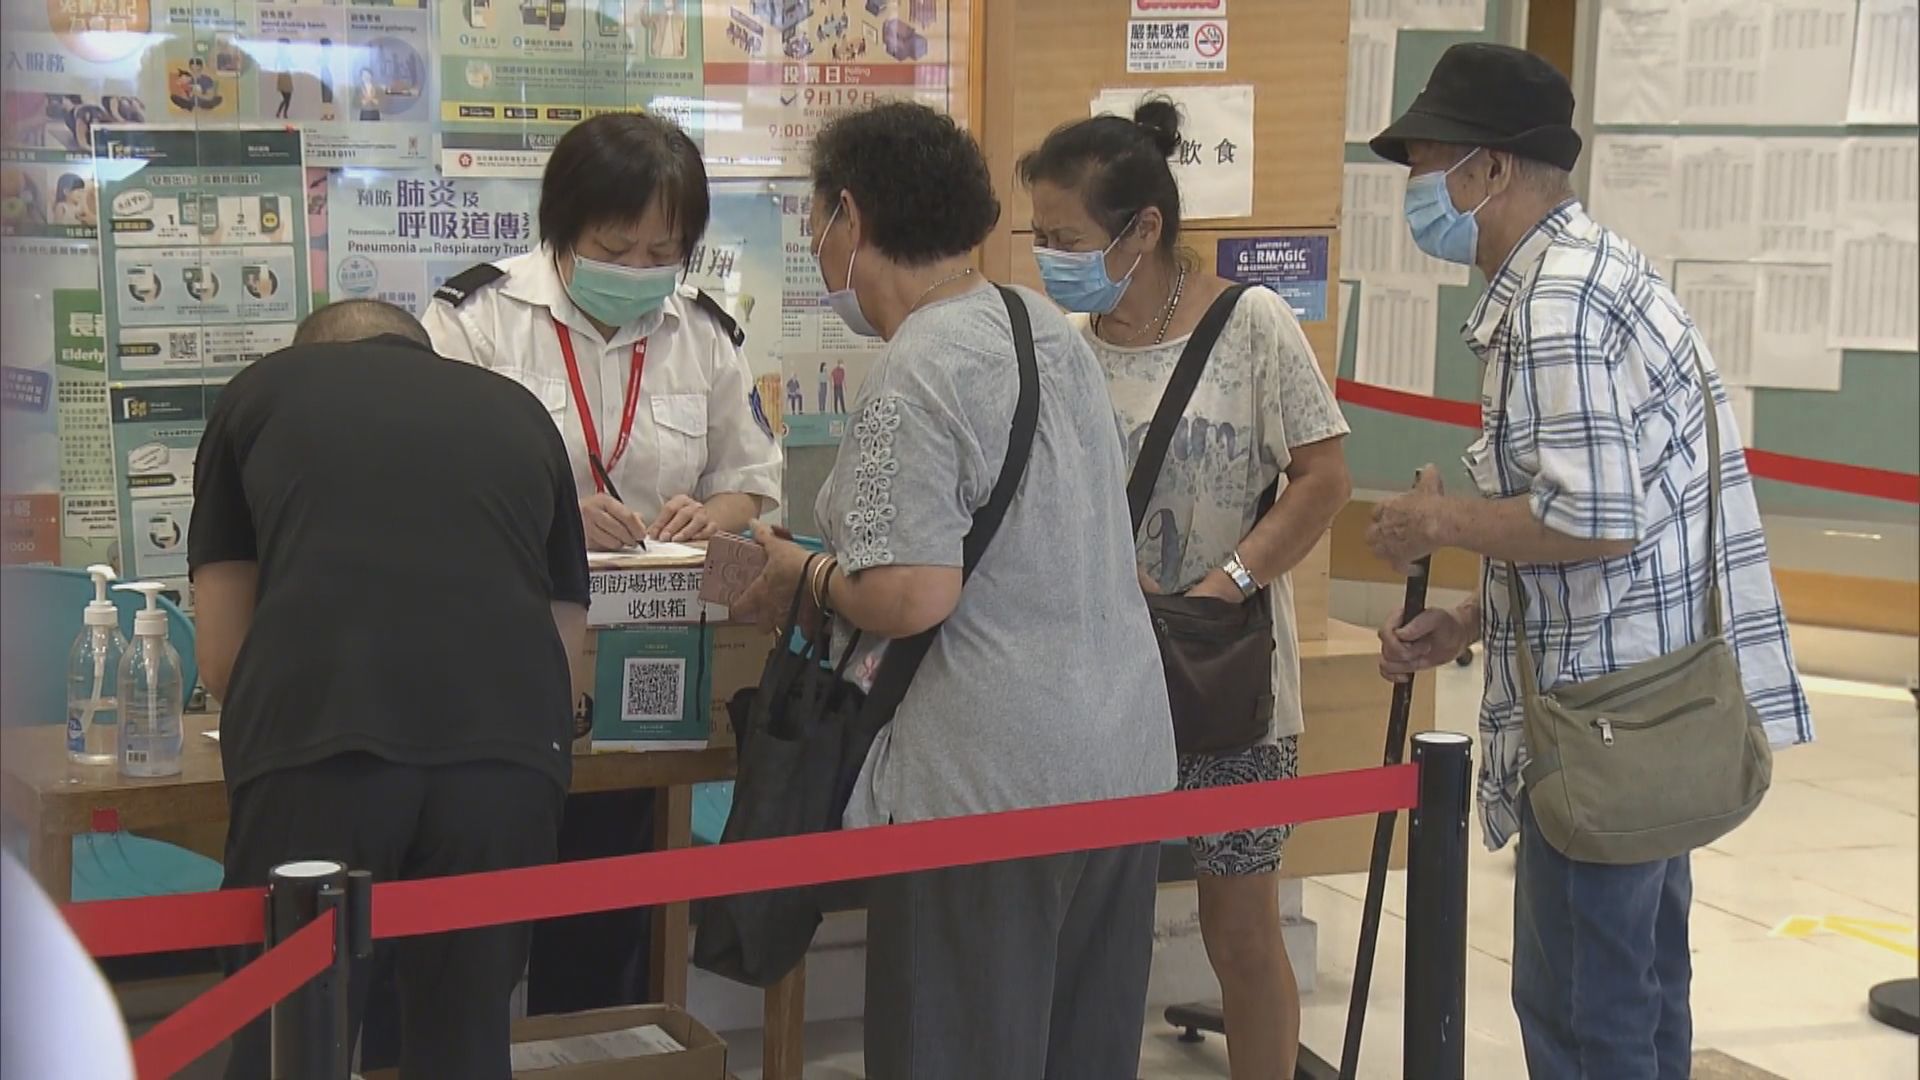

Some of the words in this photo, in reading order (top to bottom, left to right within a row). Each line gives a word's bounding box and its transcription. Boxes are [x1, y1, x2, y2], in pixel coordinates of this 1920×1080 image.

[1131, 23, 1190, 40] 嚴禁吸煙
[1130, 41, 1145, 50] NO
[1147, 41, 1190, 50] SMOKING
[1179, 138, 1237, 166] 飲食
[357, 180, 480, 208] 預防肺炎及
[348, 241, 417, 254] Pneumonia
[434, 242, 501, 257] Respiratory
[504, 244, 529, 255] Tract
[62, 348, 105, 363] Elderly
[590, 572, 701, 595] 到訪場地登記
[627, 598, 687, 620] 收集箱
